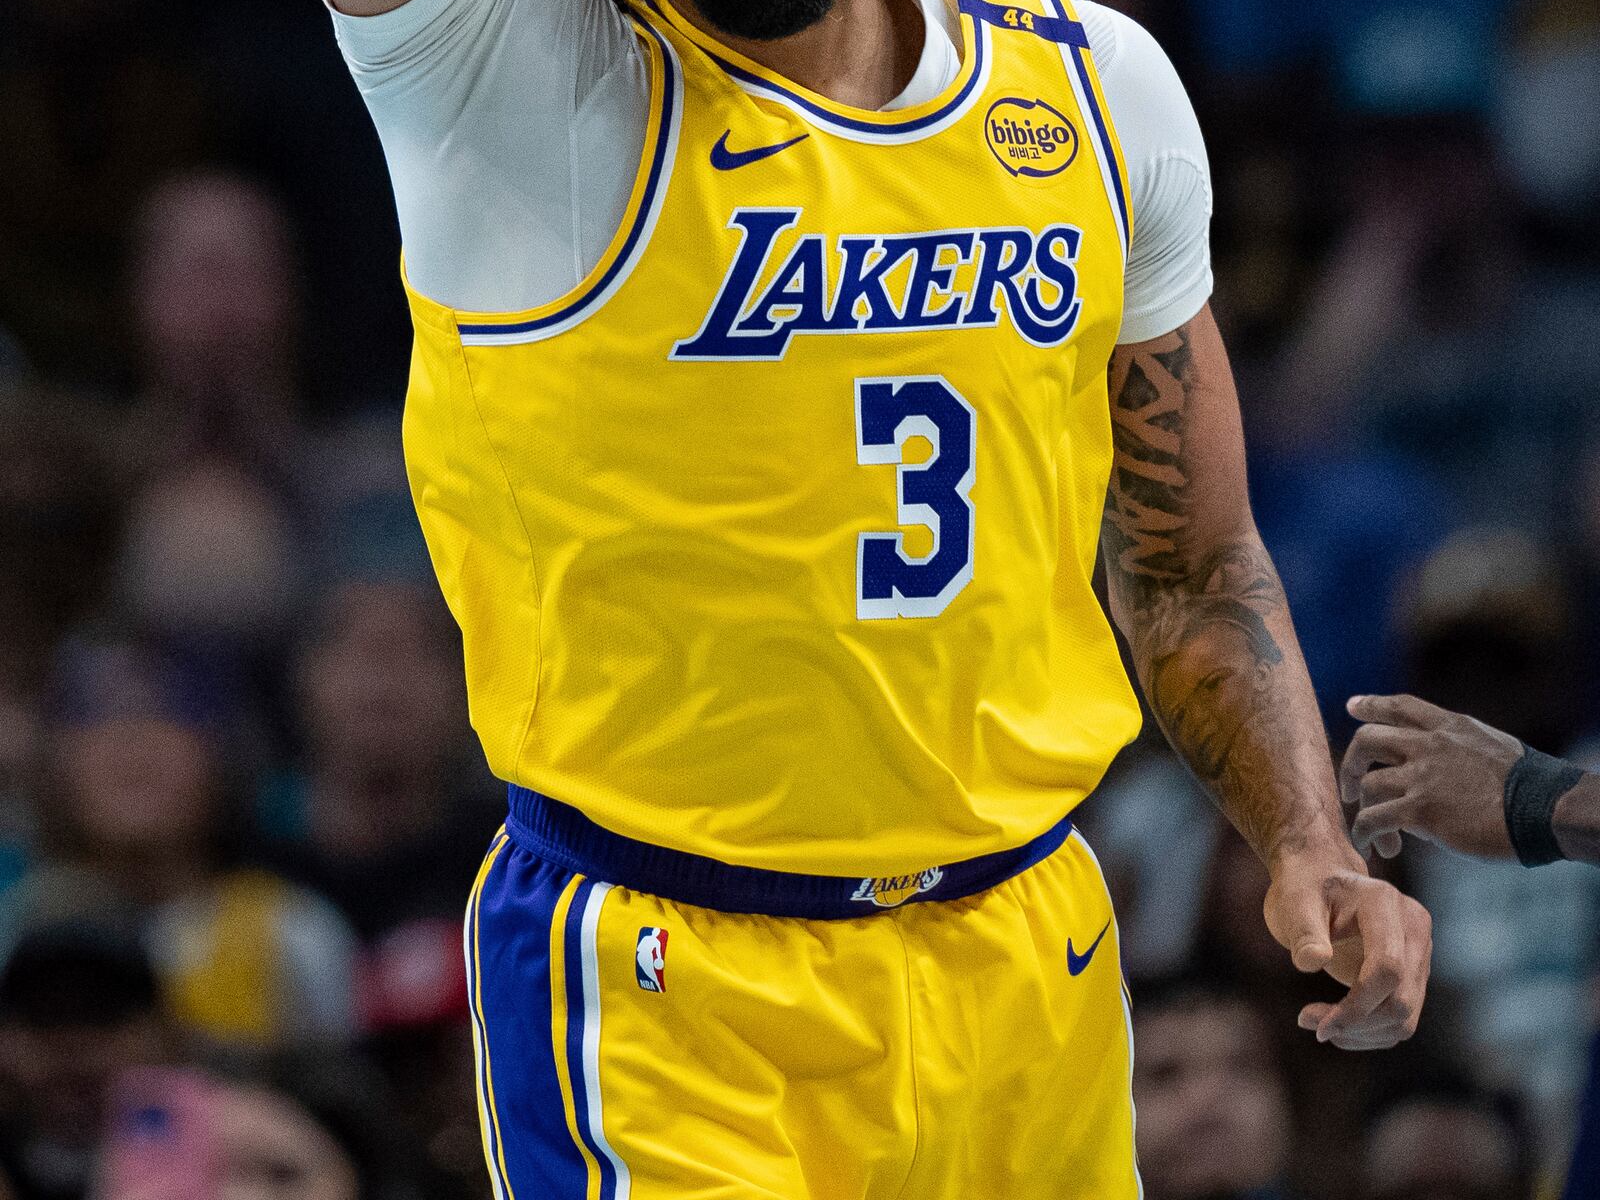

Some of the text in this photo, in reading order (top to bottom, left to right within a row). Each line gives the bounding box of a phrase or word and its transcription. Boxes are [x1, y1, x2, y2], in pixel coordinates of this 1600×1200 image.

[1003, 8, 1034, 30] 44
[990, 118, 1070, 153] bibigo
[1008, 146, 1042, 160] 비비고
[667, 206, 1084, 361] LAKERS
[854, 374, 977, 620] 3
[850, 866, 943, 901] LAKERS
[639, 979, 656, 991] NBA
